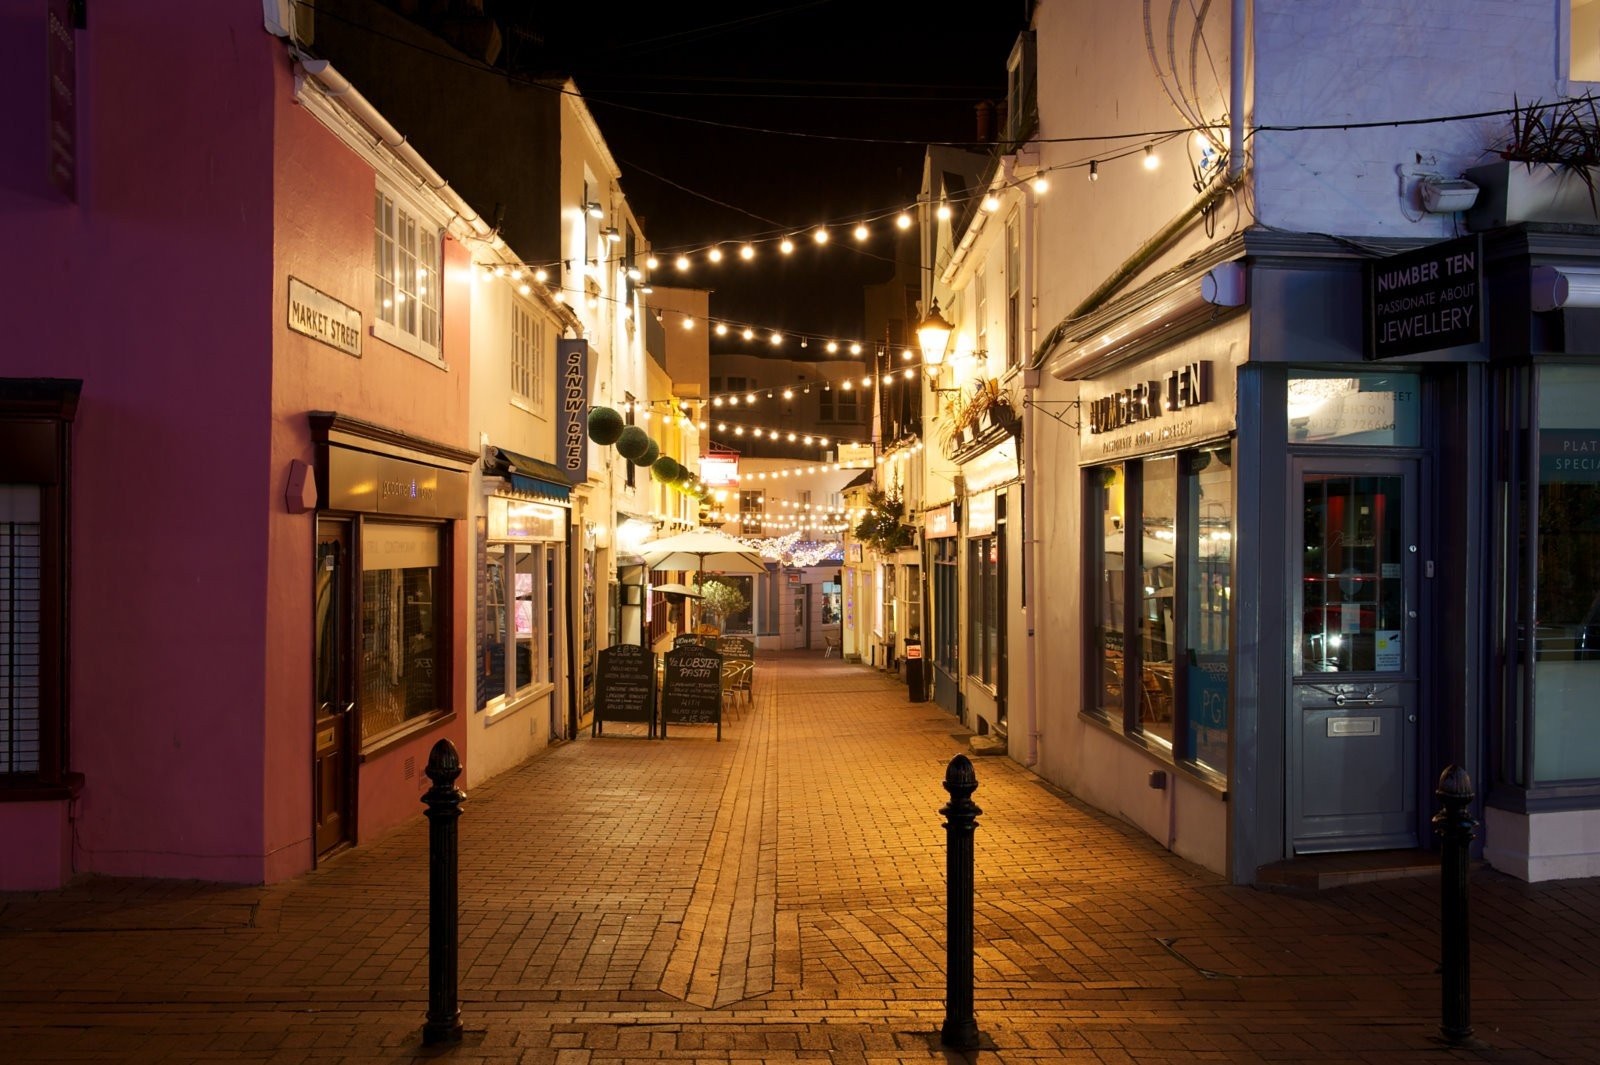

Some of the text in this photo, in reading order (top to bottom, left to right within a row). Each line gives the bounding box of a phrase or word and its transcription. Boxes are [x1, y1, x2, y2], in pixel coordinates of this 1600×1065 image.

[1377, 251, 1475, 293] NUMBER TEN
[1377, 282, 1475, 316] PASSIONATE ABOUT
[292, 300, 360, 350] MARKET STREET
[1379, 304, 1474, 344] JEWELLERY
[565, 351, 583, 470] SANDWICHES
[1090, 360, 1214, 434] NUMBER TEN
[1334, 404, 1386, 416] IGHTON
[1368, 391, 1413, 401] STREET
[1563, 440, 1598, 452] PLAT
[679, 657, 720, 668] LOBSTER
[680, 668, 711, 678] PASTA
